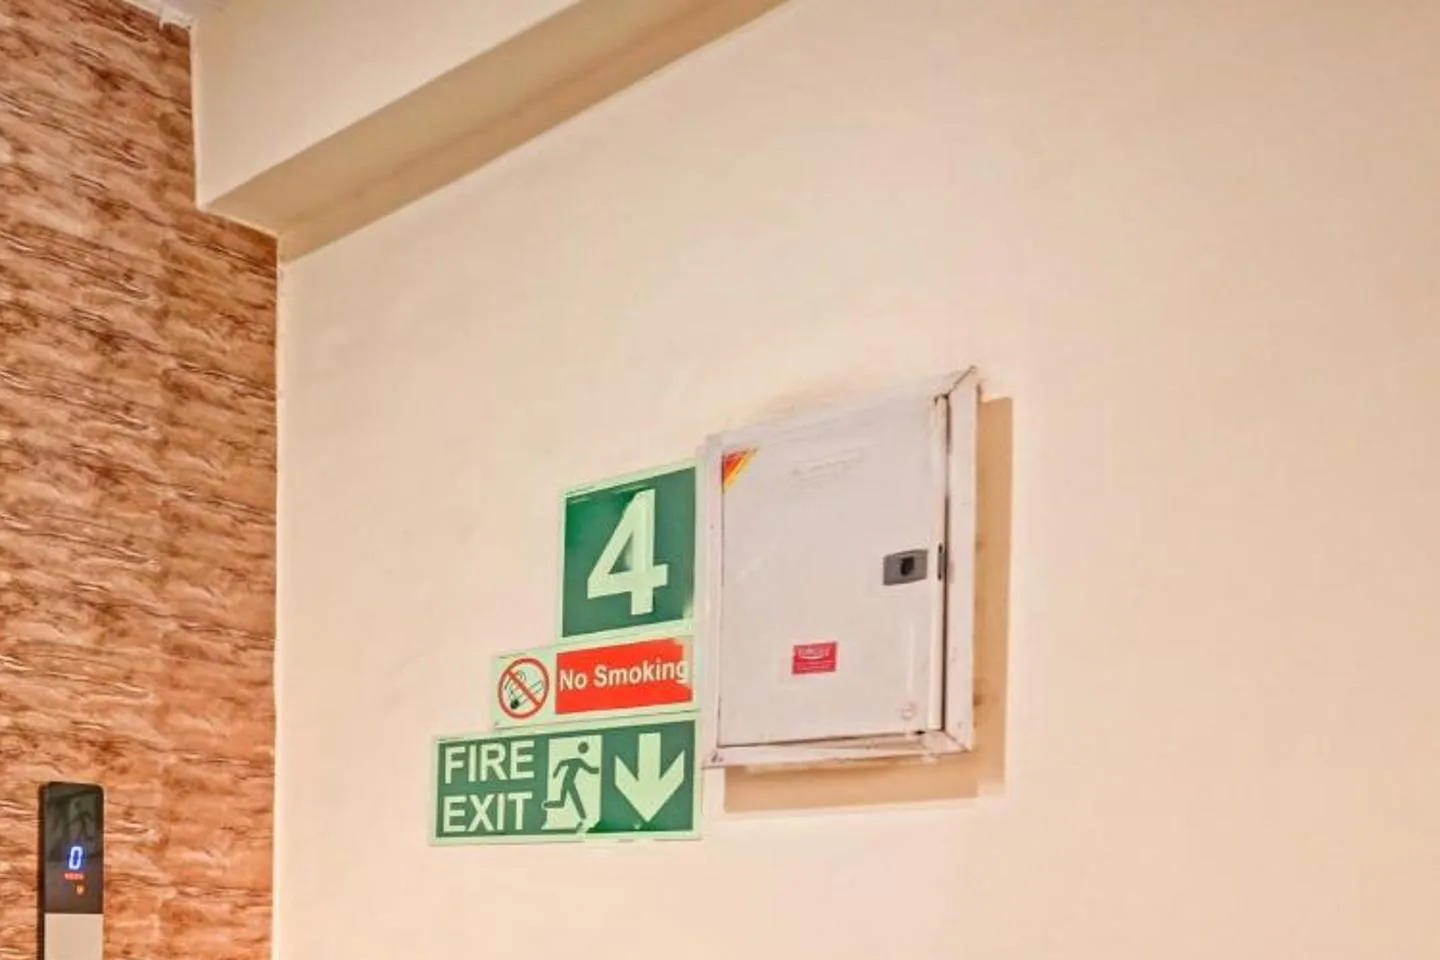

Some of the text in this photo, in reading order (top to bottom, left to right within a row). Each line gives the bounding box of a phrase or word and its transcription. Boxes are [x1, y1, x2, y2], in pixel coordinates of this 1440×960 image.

[586, 488, 669, 616] 4
[560, 656, 689, 692] No Smoking
[444, 740, 535, 785] FIRE
[442, 791, 533, 833] EXIT
[68, 845, 83, 870] 0
